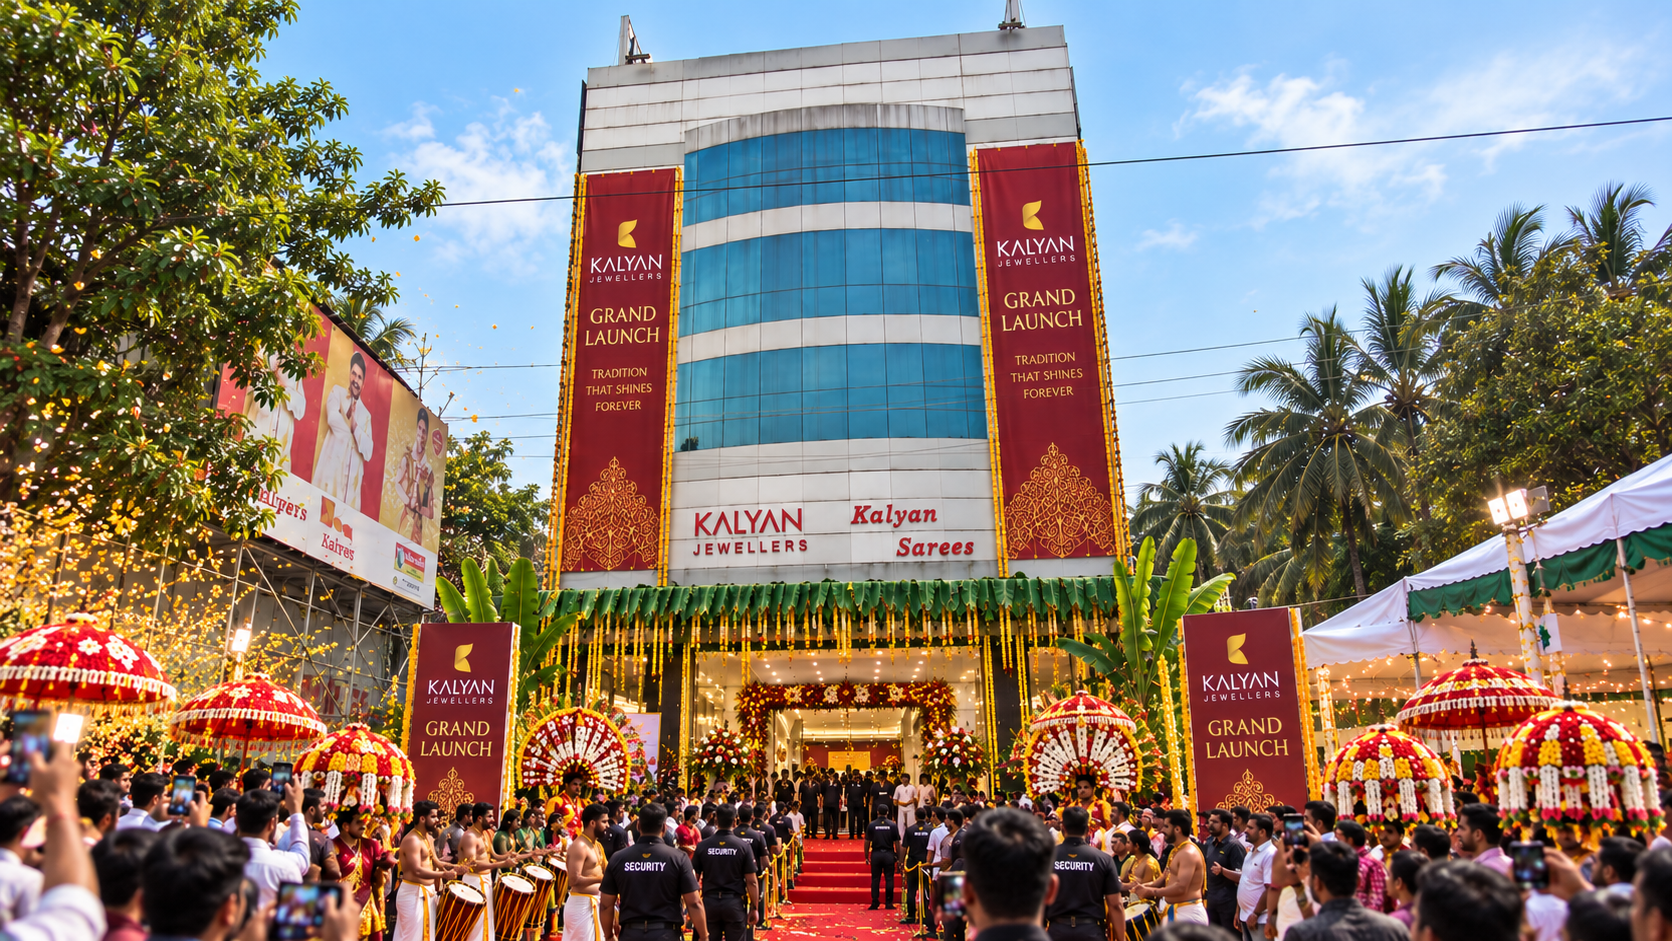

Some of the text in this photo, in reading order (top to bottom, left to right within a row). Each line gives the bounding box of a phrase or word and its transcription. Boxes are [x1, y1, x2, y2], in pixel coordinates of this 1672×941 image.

[997, 236, 1074, 257] KALYAN
[590, 254, 662, 274] KALYAN
[998, 254, 1075, 267] JEWELLERS
[589, 273, 662, 283] JEWELLERS
[1003, 288, 1076, 310] GRAND
[590, 306, 657, 325] GRAND
[1001, 309, 1083, 332] LAUNCH
[585, 327, 660, 346] LAUNCH
[1015, 351, 1076, 366] TRADITION
[591, 367, 648, 380] TRADITION
[1010, 368, 1083, 383] THAT SHINES
[586, 383, 653, 396] THAT SHINES
[1023, 386, 1074, 399] FOREVER
[595, 400, 641, 412] FOREVER
[694, 508, 803, 537] KALYAN
[850, 504, 937, 528] Kalyan
[693, 539, 808, 556] JEWELLERS
[896, 537, 974, 557] Sarees
[427, 679, 495, 695] KALYAN
[1202, 671, 1279, 692] KALYAN
[426, 697, 493, 705] JEWELLERS
[1204, 691, 1280, 702] JEWELLERS
[425, 720, 490, 736] GRAND
[1207, 717, 1282, 737] GRAND
[420, 741, 492, 757] LAUNCH
[1205, 738, 1289, 759] LAUNCH
[624, 861, 666, 872] SECURITY
[1054, 861, 1094, 872] SECURITY
